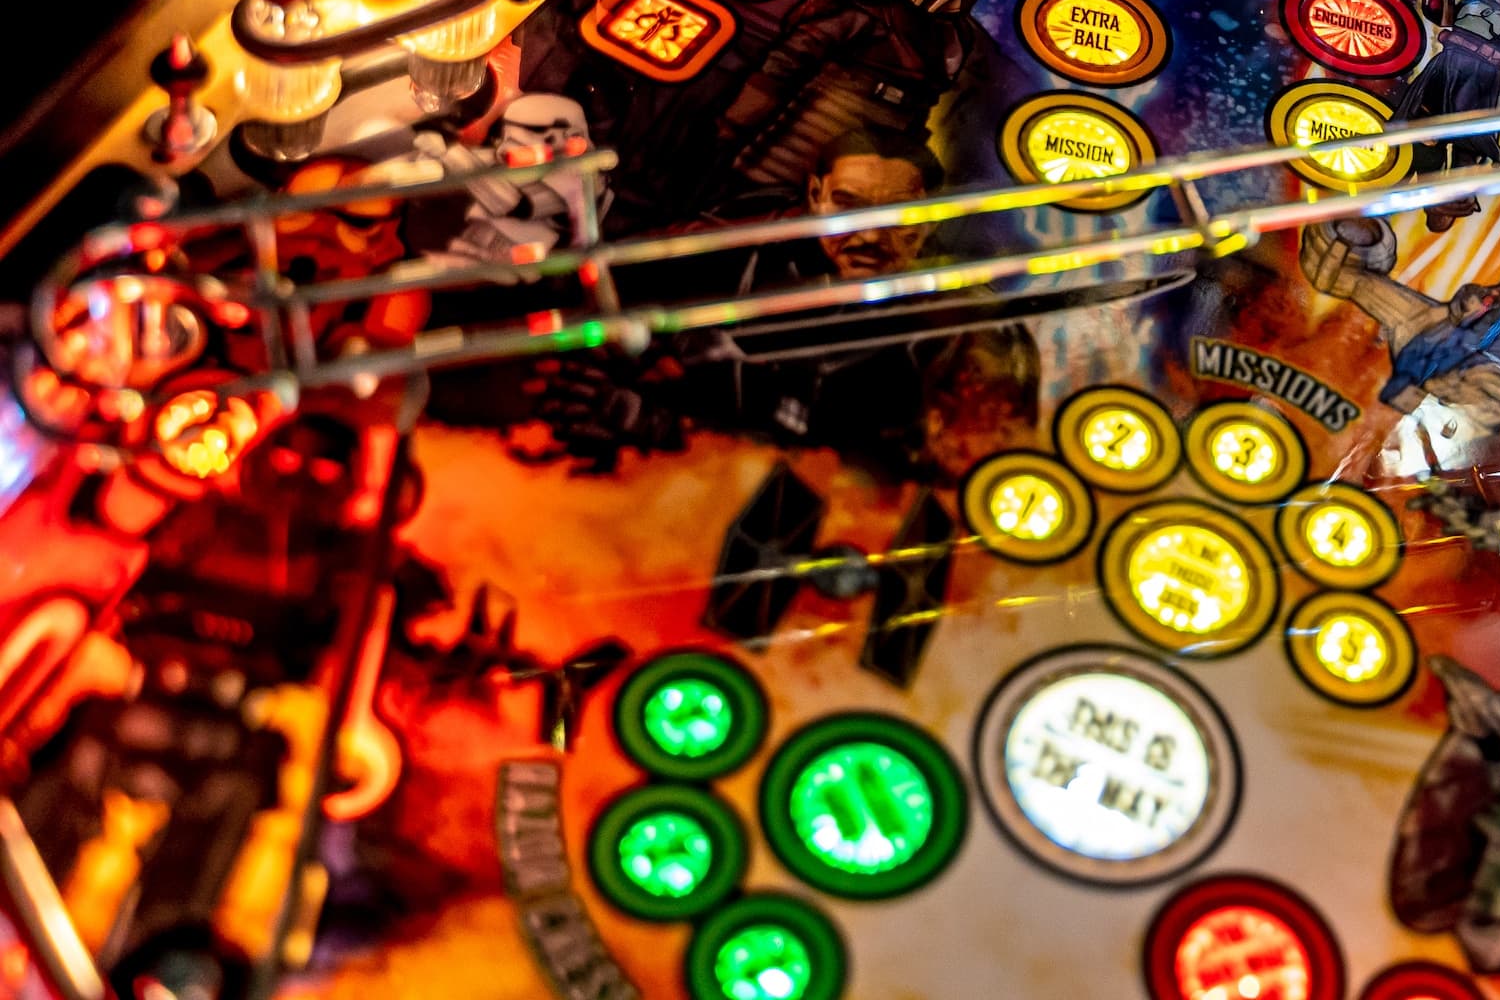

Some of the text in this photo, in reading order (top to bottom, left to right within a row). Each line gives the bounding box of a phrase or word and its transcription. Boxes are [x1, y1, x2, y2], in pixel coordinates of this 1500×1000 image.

[1071, 6, 1120, 32] EXTRA
[1313, 8, 1392, 39] ENCOUNTERS
[1074, 29, 1112, 52] BALL
[1045, 134, 1114, 165] MISSION
[1197, 342, 1357, 430] MISSIONS
[1107, 423, 1131, 452] 2
[1235, 437, 1257, 466] 3
[1332, 520, 1347, 548] 4
